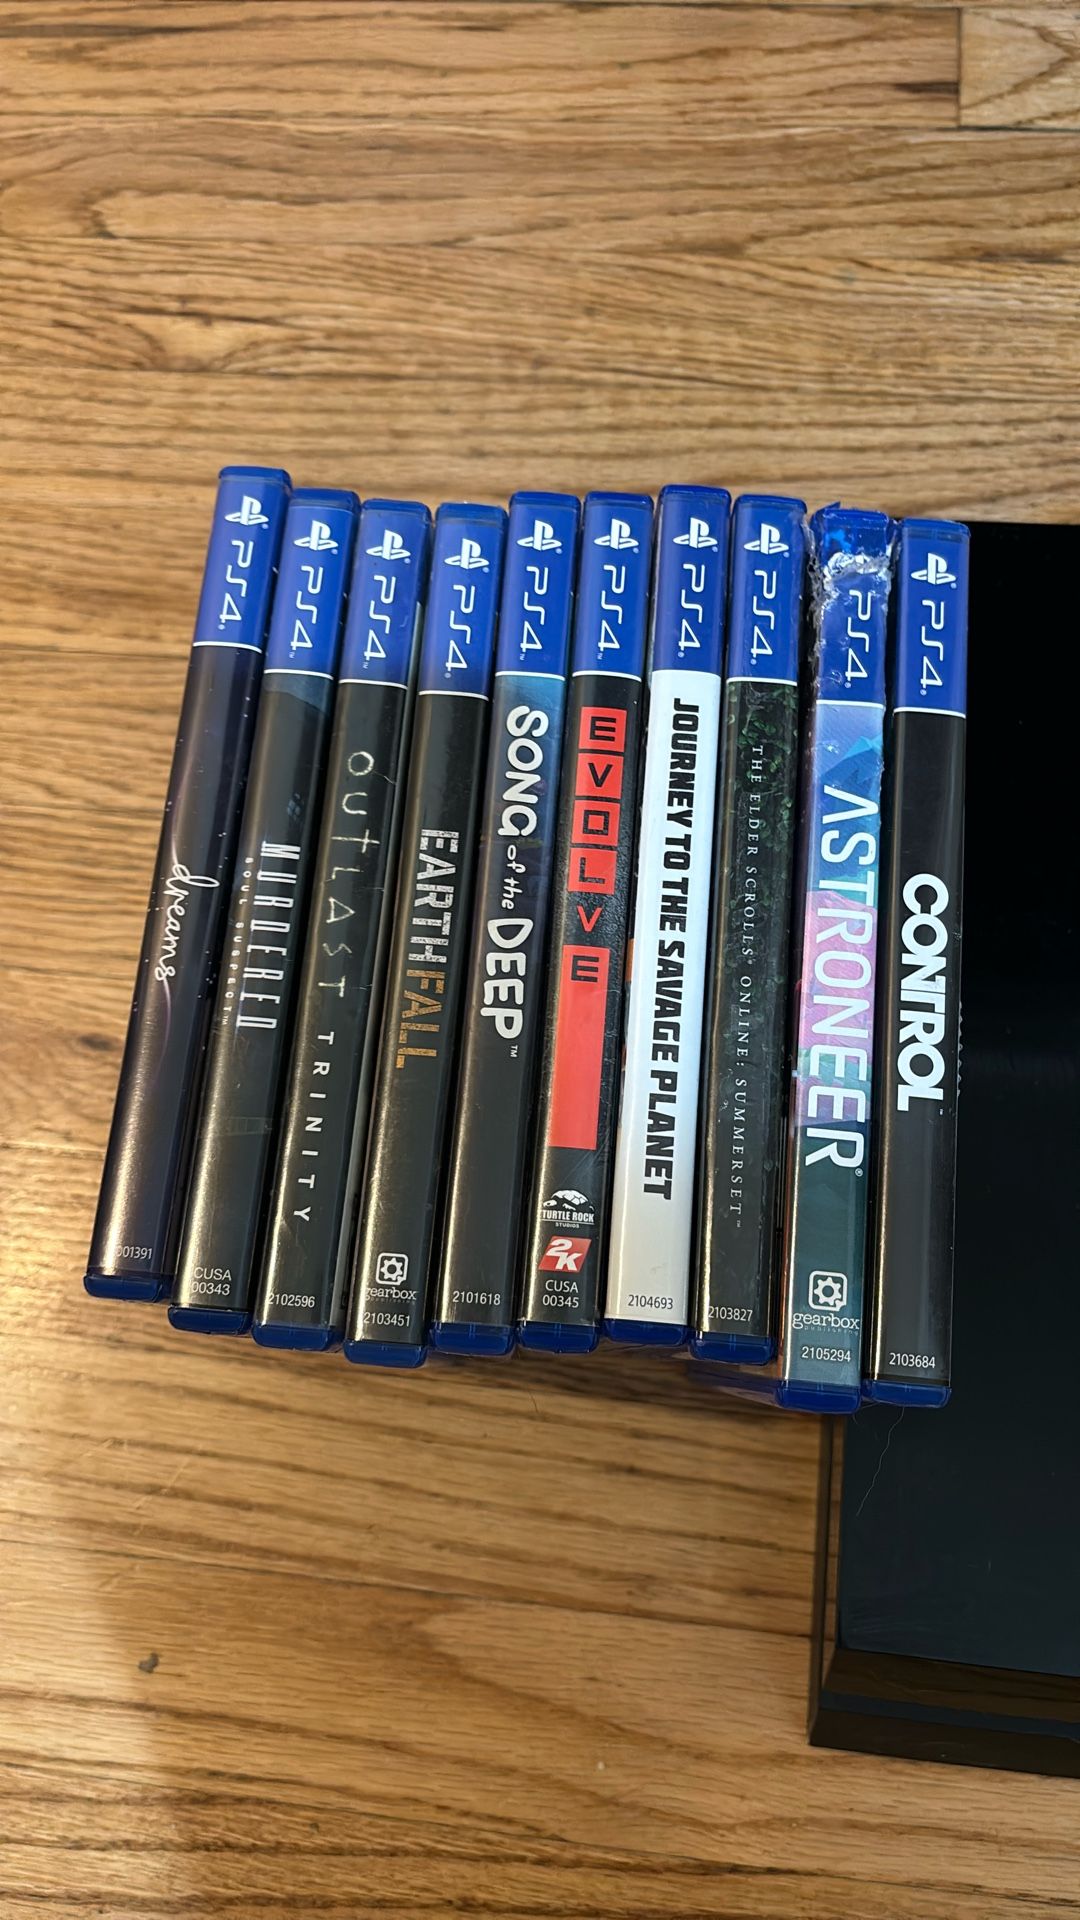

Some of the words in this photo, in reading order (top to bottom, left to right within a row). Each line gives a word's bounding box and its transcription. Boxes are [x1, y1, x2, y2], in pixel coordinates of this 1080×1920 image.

[497, 705, 549, 837] SONG
[666, 697, 700, 829] JOURNEY
[750, 744, 764, 784] THE
[746, 793, 762, 856] ELDER
[506, 844, 527, 874] of
[569, 715, 617, 983] EVOLVE
[663, 834, 692, 871] TO
[238, 857, 254, 905] SOUL
[317, 750, 381, 998] OUTLAST
[501, 877, 523, 910] the
[658, 876, 690, 933] THE
[155, 863, 220, 981] dreams
[236, 840, 301, 1029] MURDERED
[395, 828, 460, 1069] EARTHFALL
[651, 939, 686, 1064] SAVAGE
[897, 873, 949, 1112] CONTROL
[735, 975, 752, 1067] ONLINE:
[293, 1030, 335, 1222] TRINITY
[643, 1069, 679, 1200] PLANET
[541, 1209, 570, 1220] TURTLE
[572, 1212, 595, 1223] ROCK
[545, 1237, 583, 1272] 2K
[191, 1281, 231, 1296] 00343
[193, 1266, 232, 1281] CUSA
[545, 1279, 579, 1293] CUSA
[267, 1293, 316, 1308] 2102596
[364, 1287, 418, 1301] gearbox
[452, 1290, 501, 1306] 2101618
[542, 1294, 579, 1308] 00345
[628, 1294, 674, 1310] 2104693
[363, 1311, 410, 1327] 2103451
[707, 1305, 753, 1322] 2103827
[792, 1311, 860, 1330] gearbox
[801, 1346, 851, 1363] 2105294
[888, 1352, 936, 1369] 2103684
